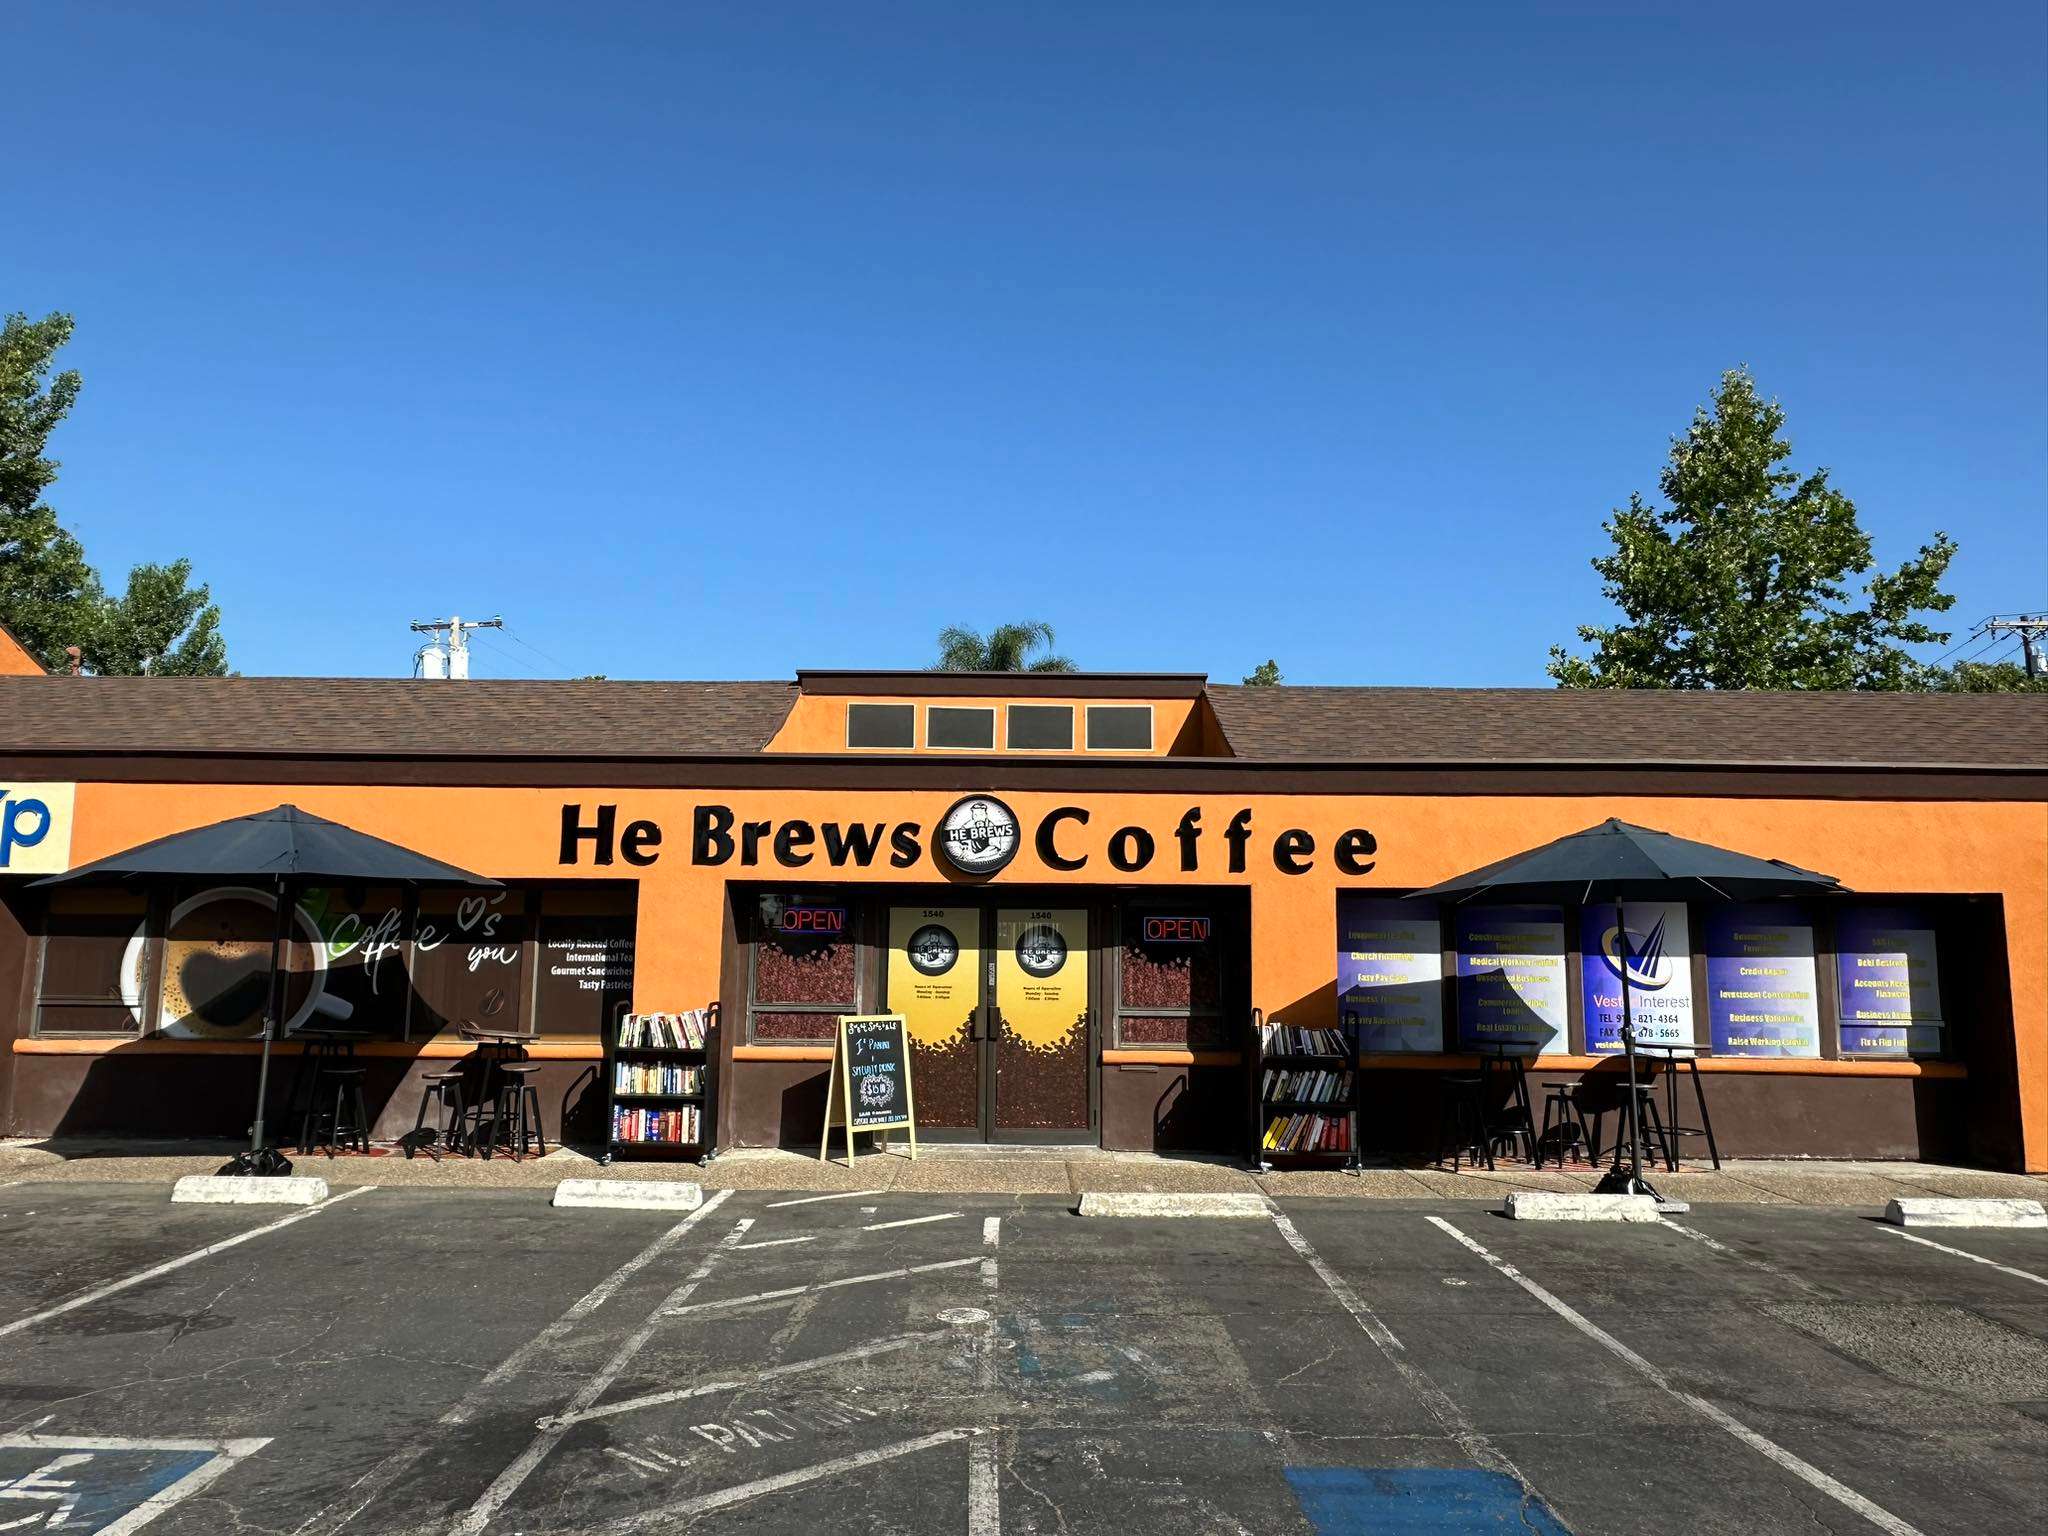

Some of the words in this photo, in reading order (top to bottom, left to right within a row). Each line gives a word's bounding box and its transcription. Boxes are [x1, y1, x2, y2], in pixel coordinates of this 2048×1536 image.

[949, 828, 968, 841] HE
[970, 825, 1014, 840] BREWS
[558, 804, 662, 866] He
[692, 804, 922, 867] Brews
[1035, 807, 1377, 875] Coffee
[922, 910, 945, 918] 1540
[1030, 912, 1052, 920] 1540
[783, 910, 842, 930] OPEN
[1147, 919, 1207, 940] OPEN
[548, 938, 576, 950] Locally
[576, 938, 608, 949] Roasted
[609, 938, 634, 949] Coffee
[467, 944, 518, 972] you
[566, 952, 619, 962] International
[620, 952, 634, 962] Tea
[550, 965, 586, 976] Gourmet
[586, 965, 633, 976] Sandwiches
[578, 980, 600, 991] Tasty
[600, 980, 632, 990] Pastries
[1640, 994, 1691, 1009] Interest
[1599, 1014, 1612, 1023] TEL
[1599, 1028, 1614, 1037] FAX
